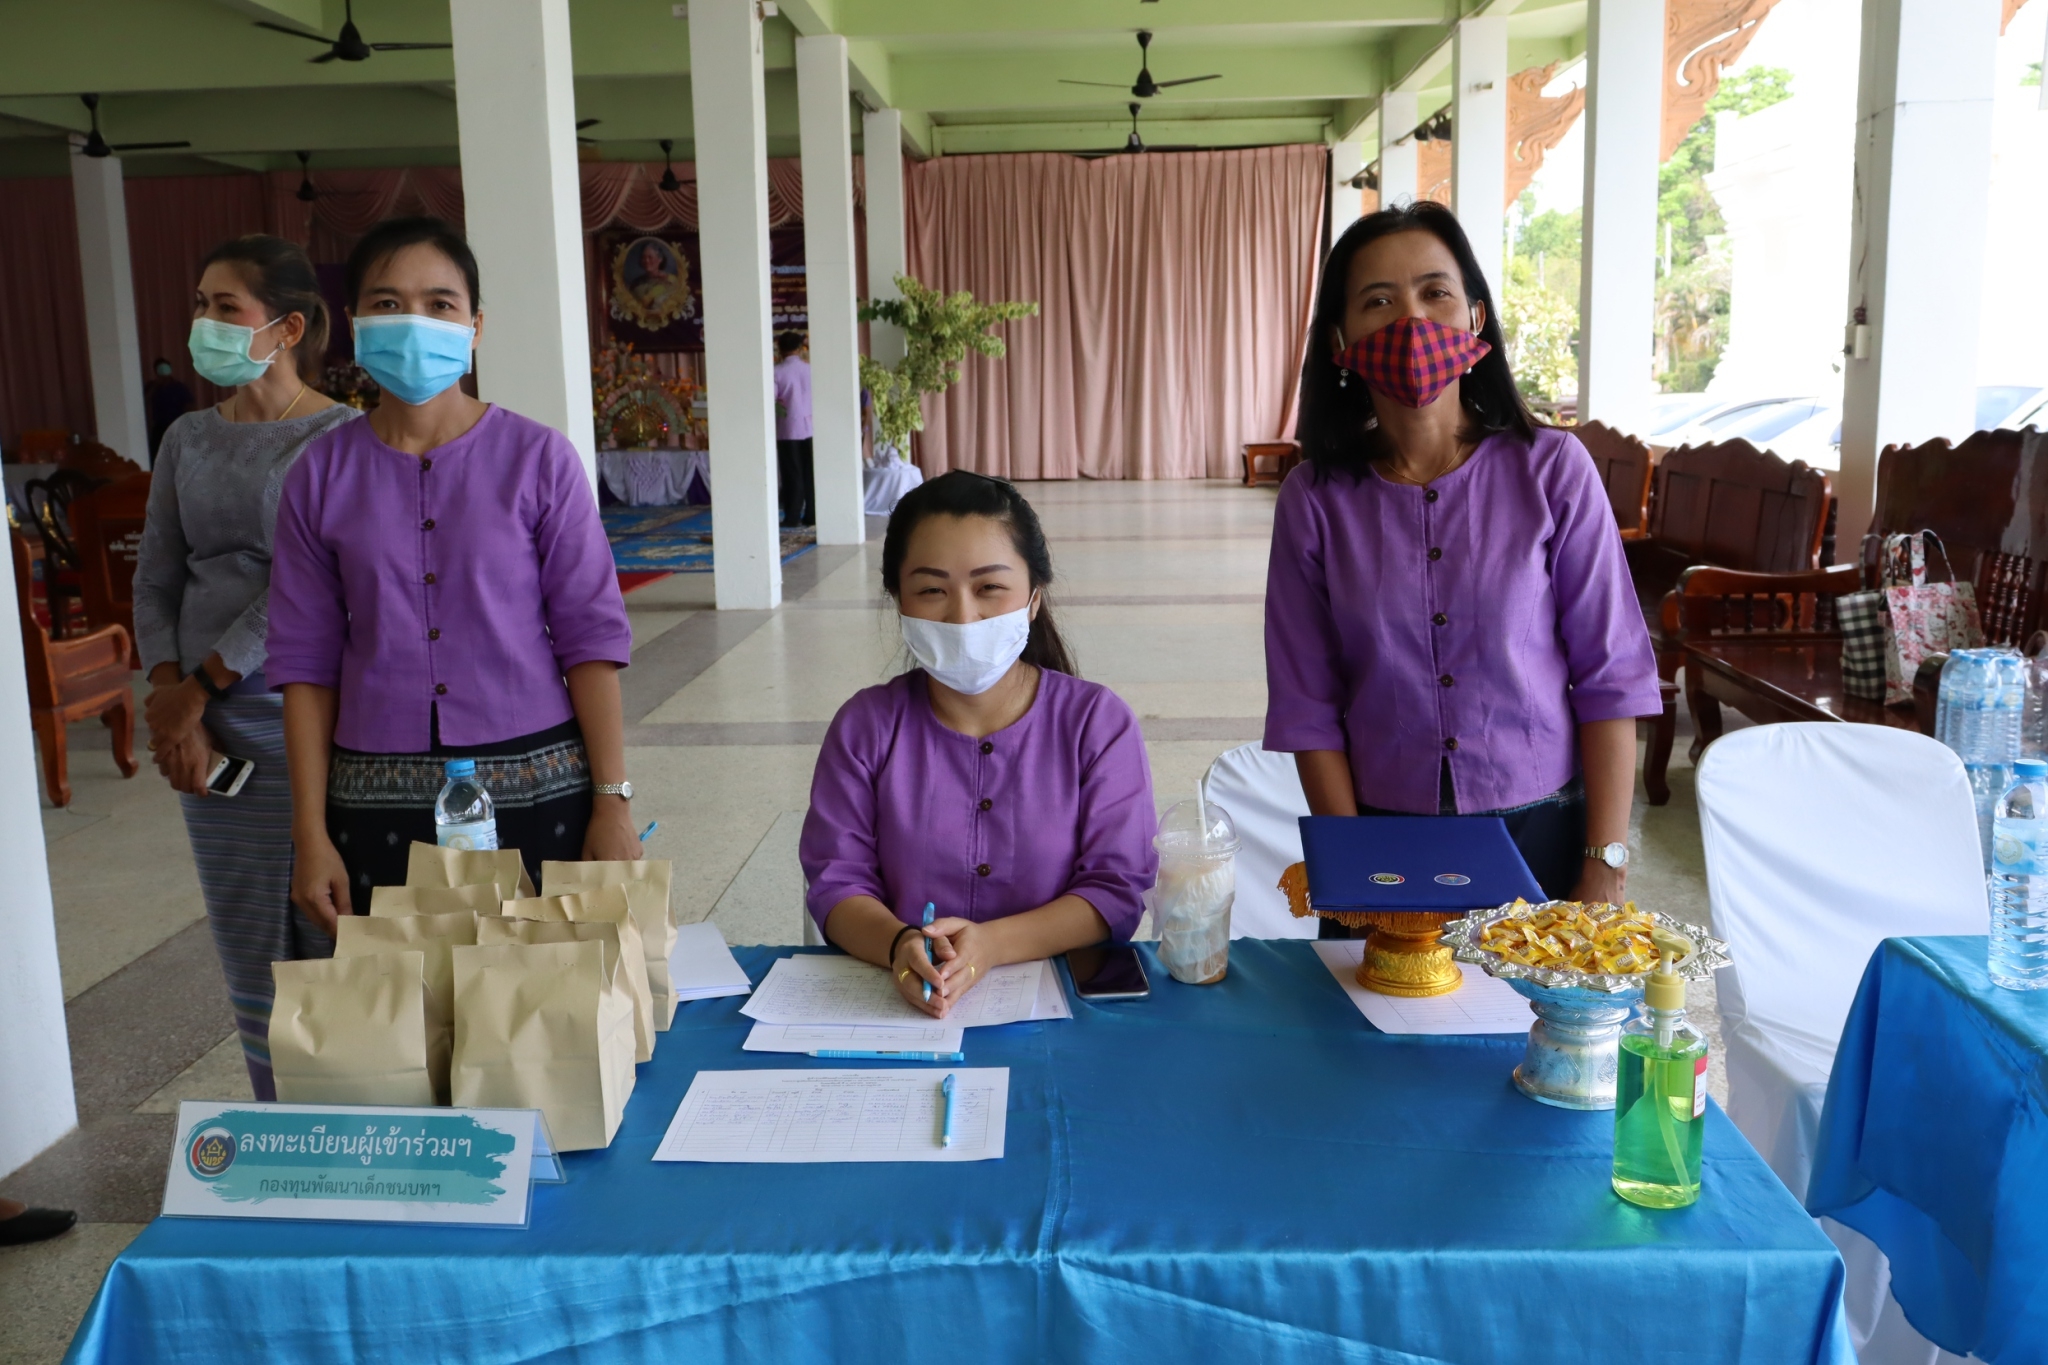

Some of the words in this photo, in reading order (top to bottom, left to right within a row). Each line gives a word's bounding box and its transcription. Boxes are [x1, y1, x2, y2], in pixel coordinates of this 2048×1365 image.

[240, 1125, 472, 1165] ลงทะเบียนผู้เข้าร่วมฯ
[259, 1174, 441, 1198] กองทุนพัฒนาเด็กชนบทฯ
